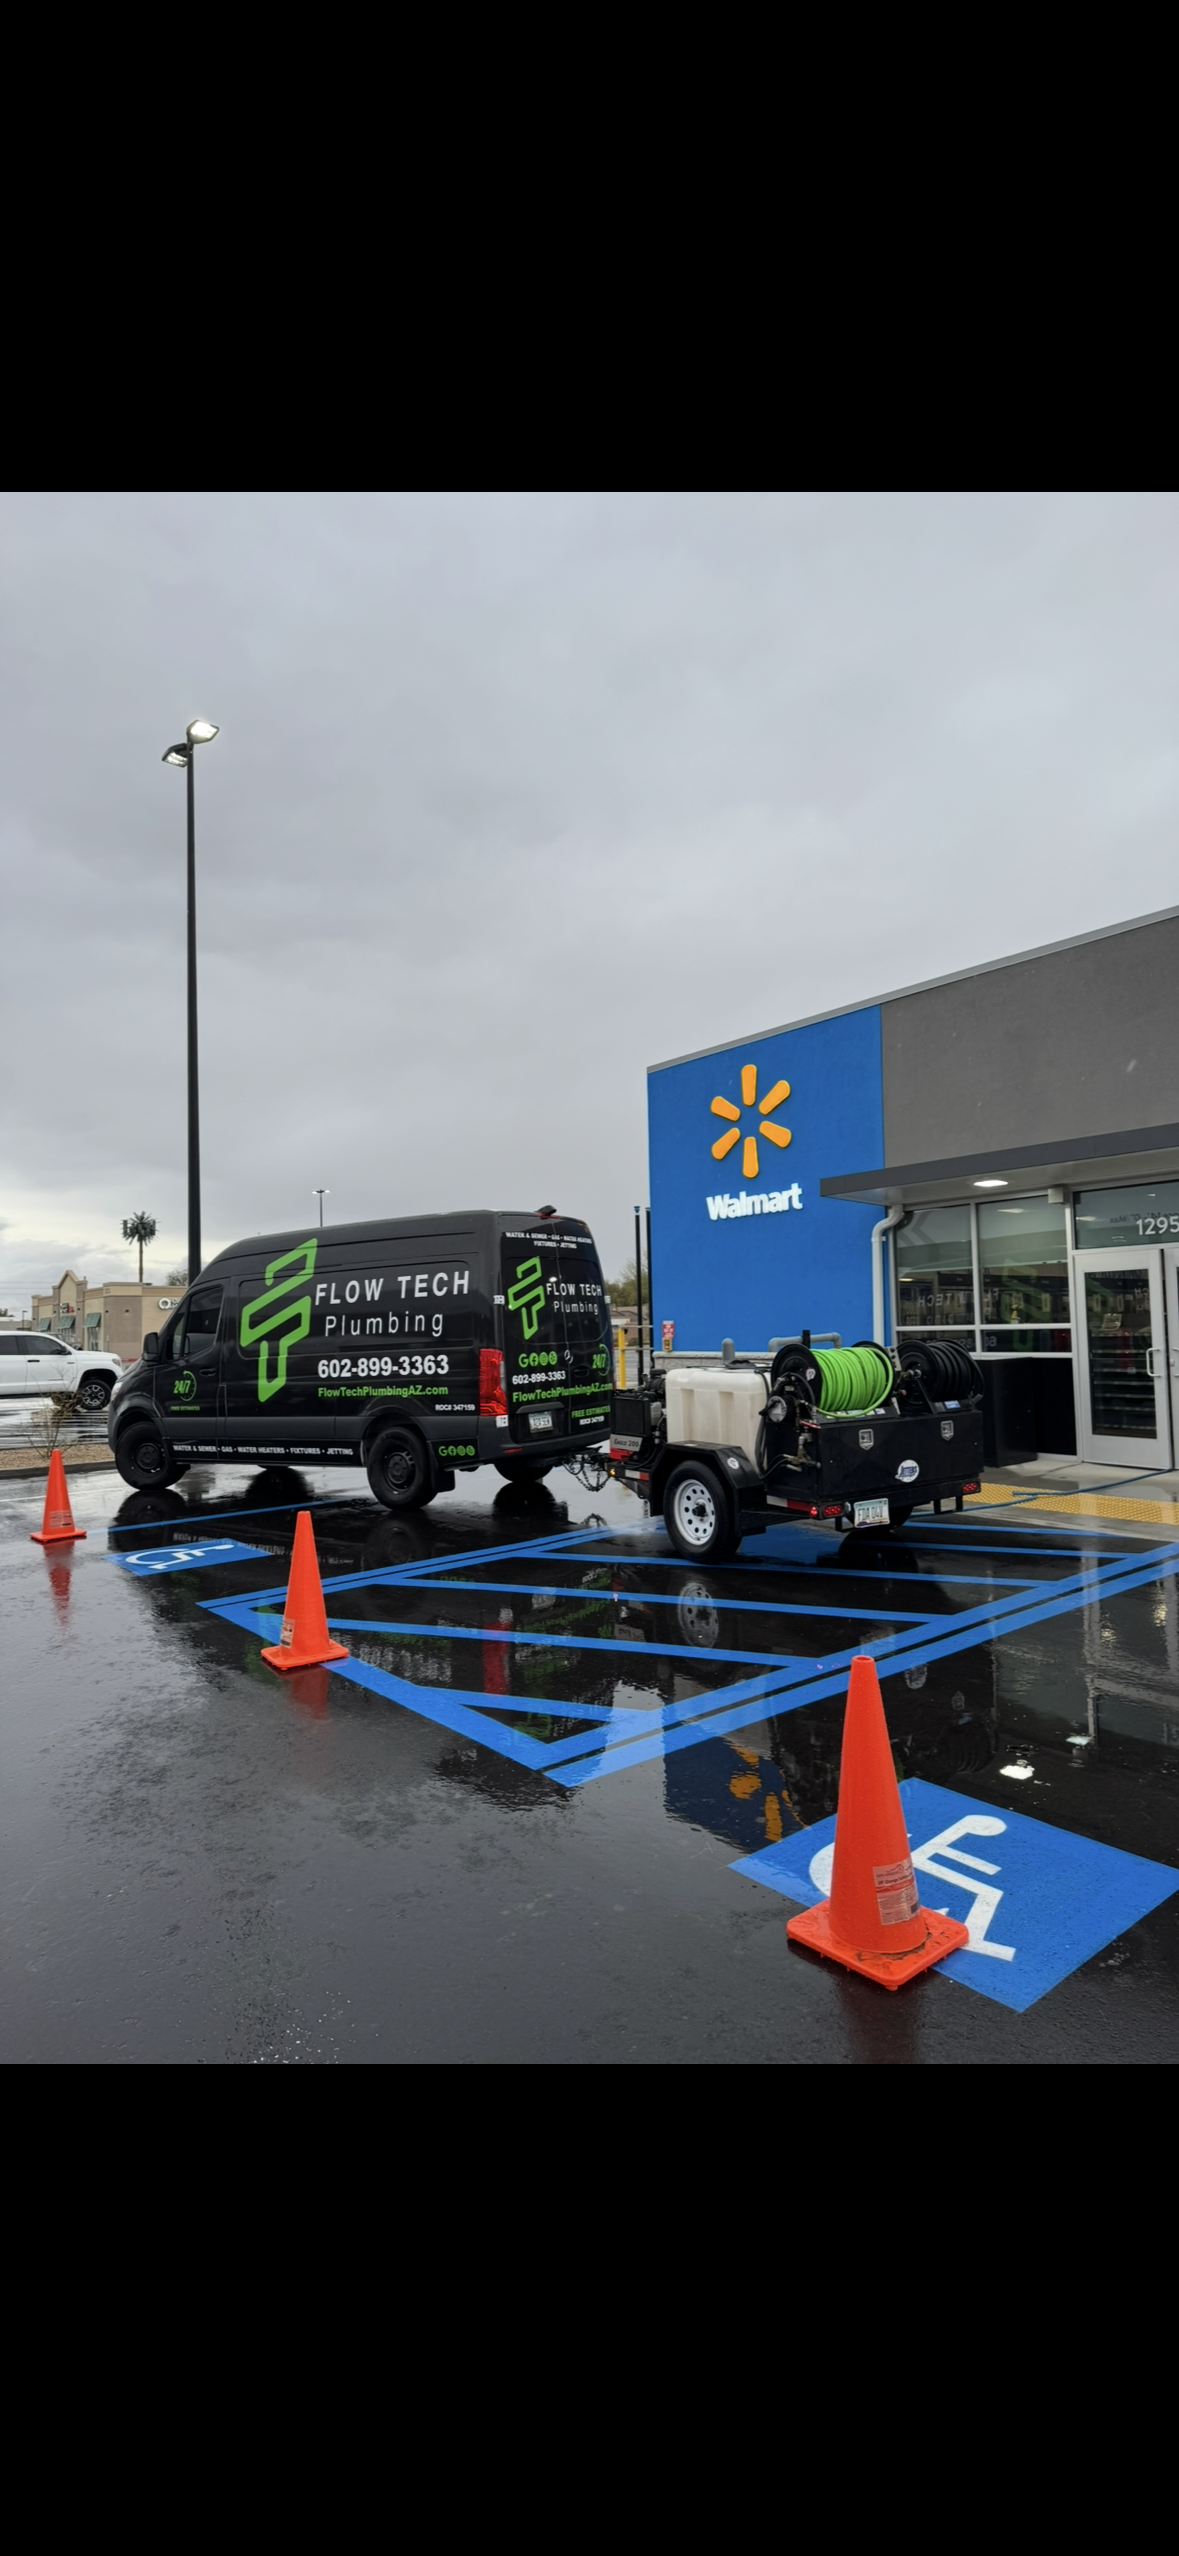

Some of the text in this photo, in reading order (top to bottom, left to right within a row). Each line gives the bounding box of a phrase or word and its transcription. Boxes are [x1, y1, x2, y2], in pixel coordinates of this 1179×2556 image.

[706, 1183, 803, 1221] Walmart
[315, 1270, 470, 1306] FLOW TECH
[545, 1283, 603, 1297] FLOW TECH
[553, 1300, 599, 1315] Plumbing
[325, 1310, 443, 1337] Plumbing
[317, 1354, 449, 1378] 602-899-3363
[592, 1353, 607, 1369] 24/7
[512, 1370, 566, 1385] 602-899-3363
[173, 1380, 192, 1394] 24/7
[318, 1384, 449, 1398] FlowTechPlumbingAZ.com
[512, 1382, 613, 1402] FlowTechPlumbingAZ.com
[453, 1403, 476, 1411] 347159
[571, 1405, 611, 1418] FREE ESTIMATES
[290, 1447, 321, 1455] FIXTURES
